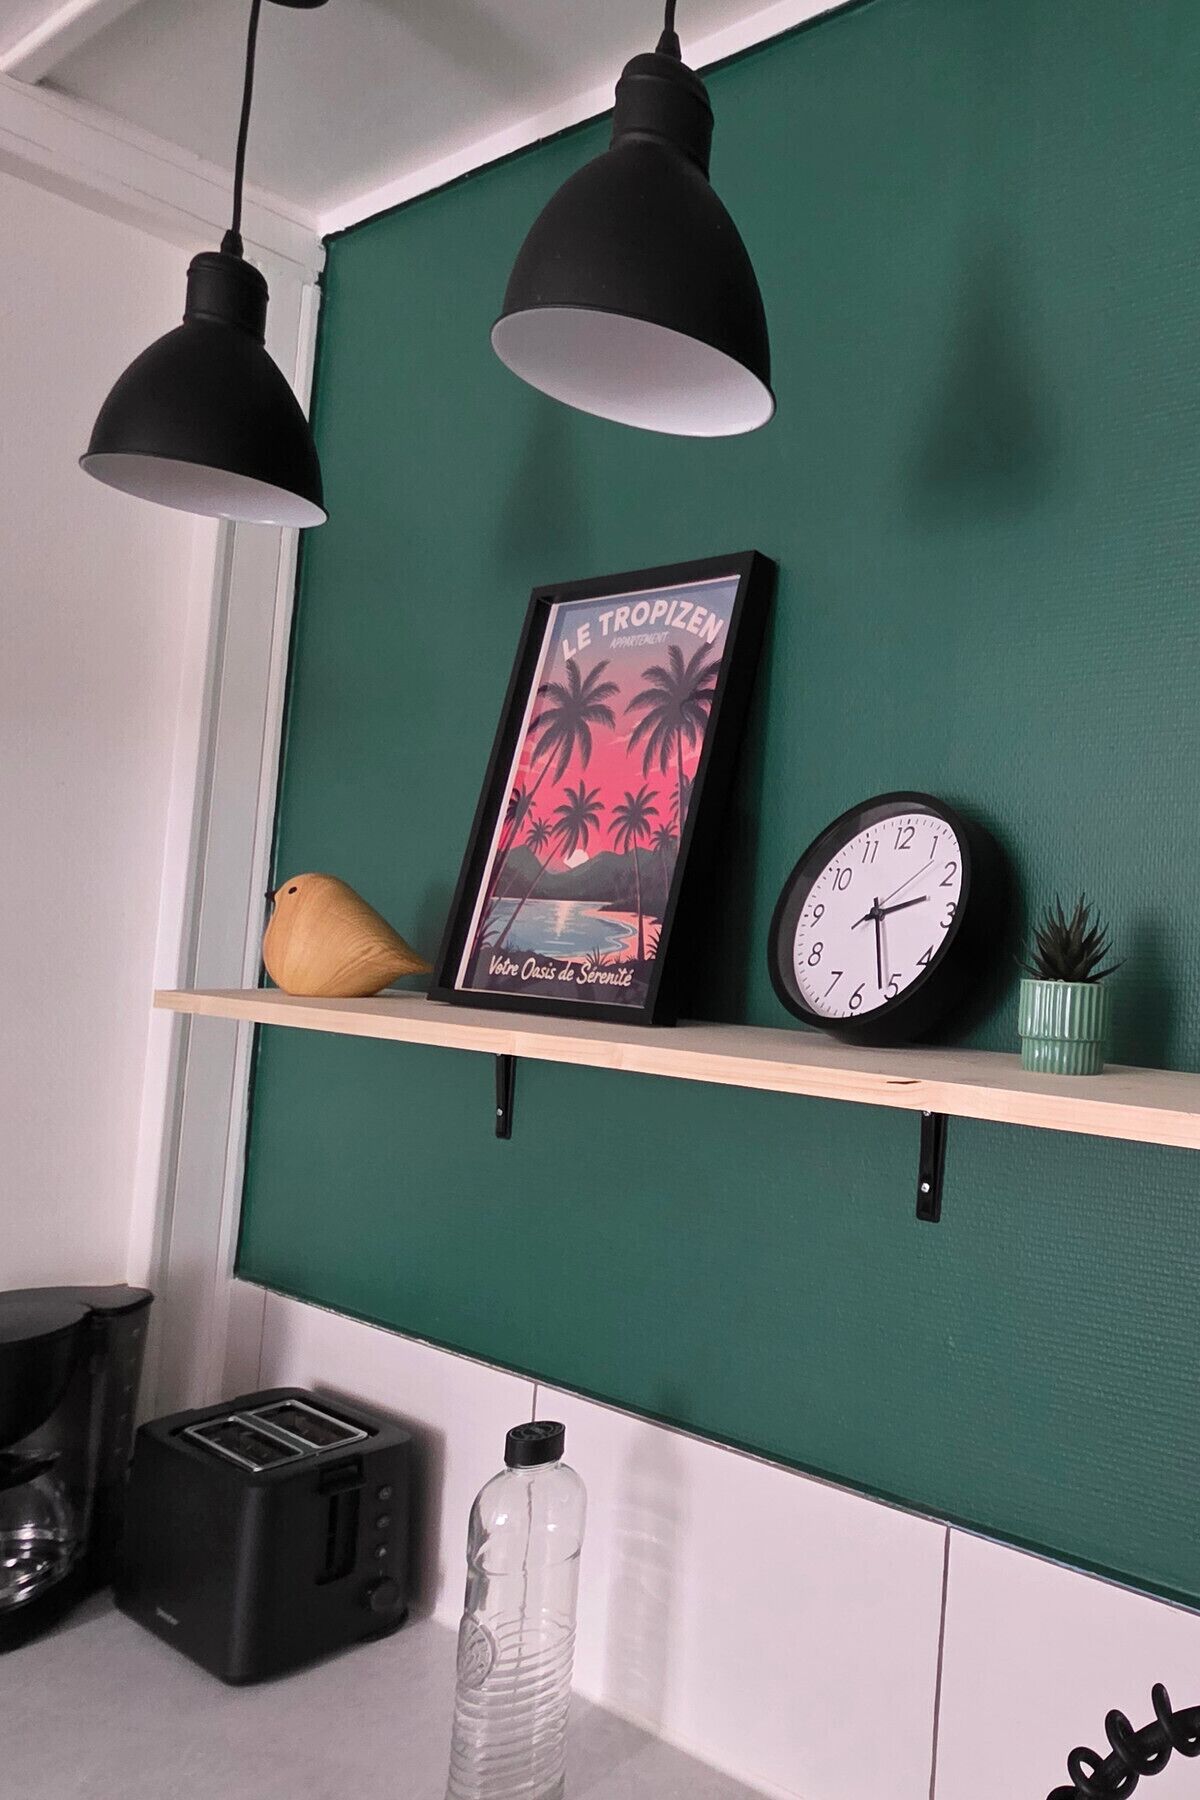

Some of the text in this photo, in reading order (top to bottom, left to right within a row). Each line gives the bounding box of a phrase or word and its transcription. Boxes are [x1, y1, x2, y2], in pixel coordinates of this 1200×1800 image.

[562, 599, 725, 661] LE TROPIZEN
[609, 631, 669, 649] APPARTEMENT
[894, 826, 915, 850] 12
[929, 835, 939, 859] 1
[861, 840, 879, 863] 11
[832, 867, 852, 891] 10
[939, 861, 957, 886] 2
[810, 904, 825, 928] 9
[939, 902, 957, 929] 3
[807, 942, 824, 967] 8
[916, 945, 934, 967] 4
[489, 955, 519, 976] Votre
[521, 957, 557, 981] Oasis
[558, 961, 574, 981] de
[824, 971, 843, 998] 7
[848, 982, 866, 1010] 6
[884, 974, 902, 1001] 5
